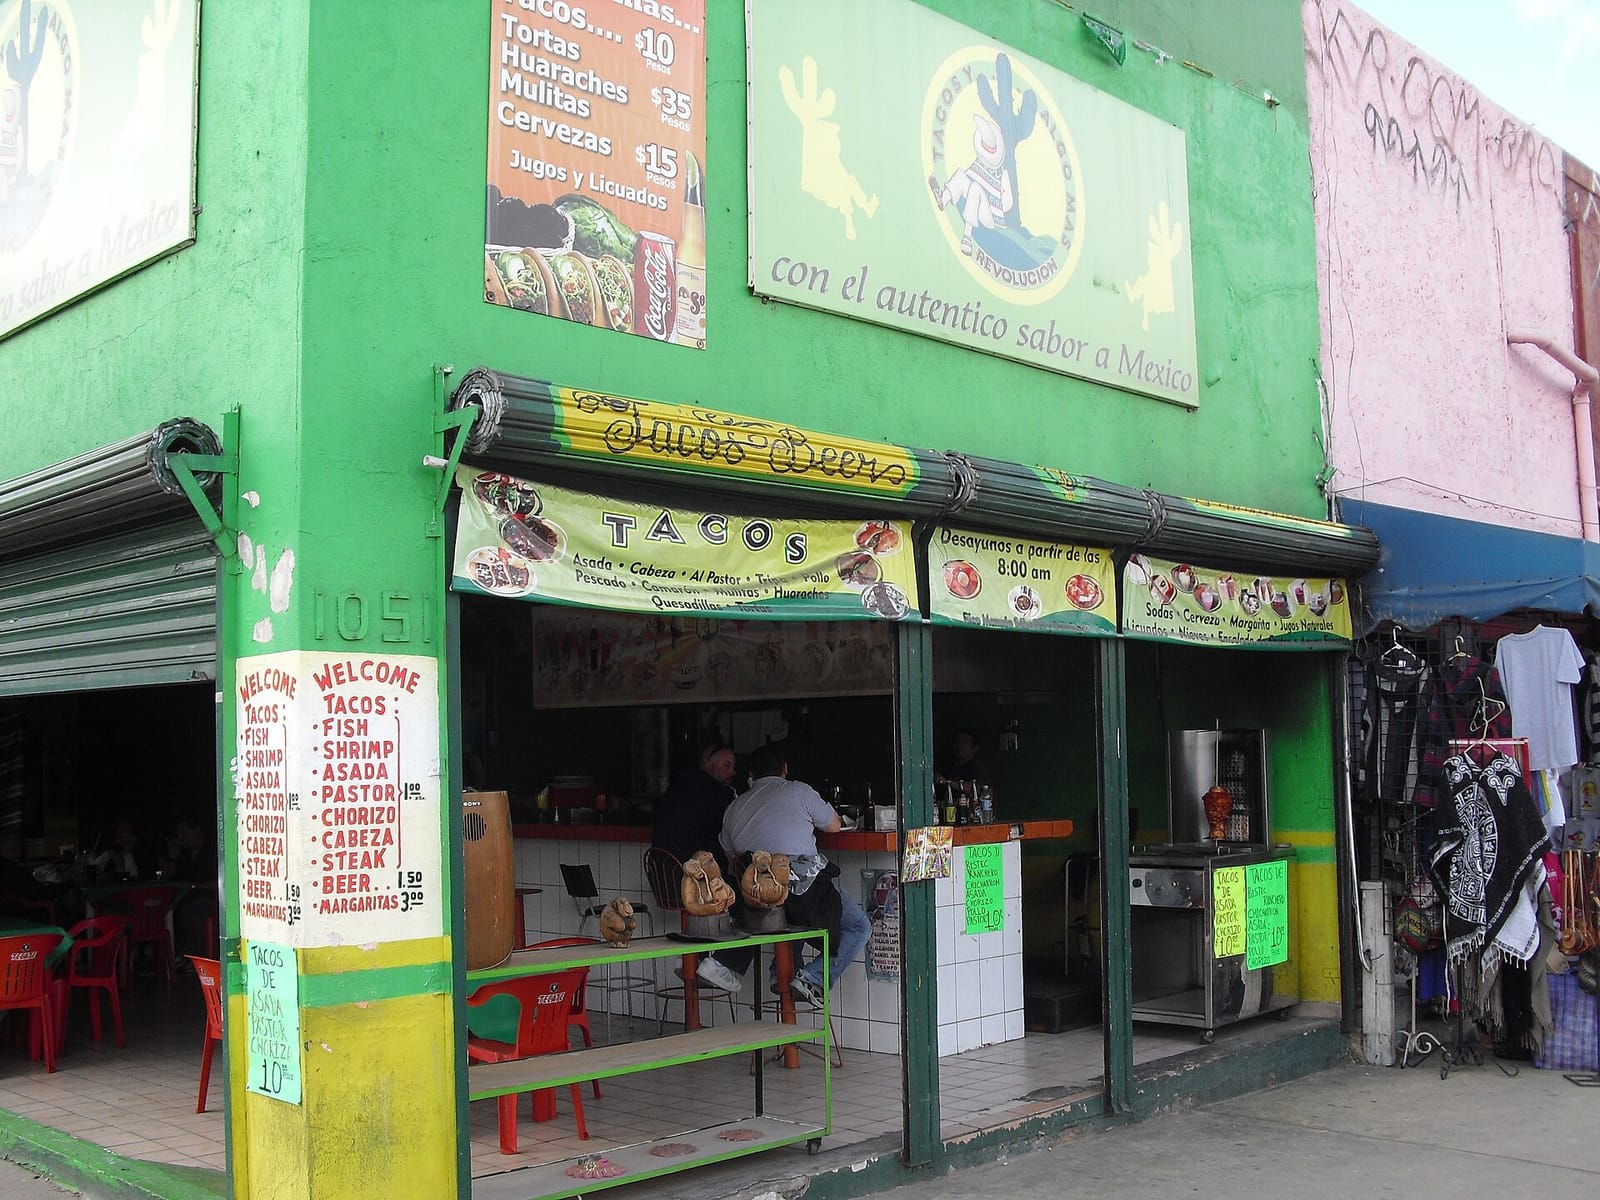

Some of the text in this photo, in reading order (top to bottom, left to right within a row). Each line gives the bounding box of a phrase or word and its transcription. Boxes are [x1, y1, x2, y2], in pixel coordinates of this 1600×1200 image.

[513, 0, 622, 43] acos....
[500, 12, 581, 61] Tortas
[634, 27, 675, 66] $10
[500, 40, 629, 104] Huaraches
[646, 59, 672, 76] Pesos
[500, 68, 592, 118] Mulitas
[650, 87, 692, 120] $35
[497, 101, 613, 157] Cervezas
[662, 114, 691, 132] Pesos
[635, 143, 678, 179] $15
[933, 75, 962, 162] TACOS
[1040, 110, 1072, 181] ALGO
[1061, 192, 1076, 250] MAS
[510, 149, 668, 211] Jugos y Licuados
[646, 172, 677, 189] Pesos
[975, 253, 1058, 288] REVOLUCION
[771, 256, 1193, 393] con el autentico sabor a Mexico
[602, 510, 808, 565] TACOS
[940, 528, 1100, 564] Desayunos a partir de las
[573, 552, 612, 571] Asada
[630, 561, 676, 579] Cabeza
[689, 569, 704, 583] Al
[706, 570, 741, 585] Pastor
[803, 571, 830, 584] Pollo
[997, 557, 1051, 580] 8:00 am
[575, 569, 626, 588] Pescado
[774, 586, 830, 600] Huaraches
[651, 595, 723, 611] Quesadillas
[1146, 603, 1334, 633] Sodas Cerveza Margarita Jugos Naturales
[240, 668, 297, 704] WELCOME
[313, 660, 421, 694] WELCOME
[245, 727, 269, 746] FISH
[322, 718, 368, 738] FISH
[245, 749, 283, 768] SHRIMP
[323, 740, 394, 759] SHRIMP
[246, 771, 280, 790] ASADA
[322, 762, 389, 782] ASADA
[246, 792, 285, 811] PASTOR
[322, 784, 395, 803] PASTOR
[246, 815, 285, 834] CHORIZO
[321, 806, 396, 827] CHORIZO
[246, 836, 284, 856] CABEZA
[322, 828, 394, 849] CABEZA
[322, 848, 387, 871] STEAK
[966, 846, 992, 858] TACOS
[247, 857, 280, 878] STEAK
[1249, 867, 1273, 884] TACOS
[1216, 872, 1239, 885] TACOS
[966, 889, 987, 898] ASADA
[1221, 886, 1231, 898] DE
[246, 902, 286, 922] MARGARITAS
[319, 895, 399, 915] MARGARITAS
[1216, 899, 1236, 911] ASADA
[1216, 911, 1239, 924] PASTOR
[251, 945, 284, 968] TACOS
[262, 968, 276, 989] DE
[252, 990, 284, 1018] ASADA
[251, 1011, 288, 1042] PASTOR
[251, 1036, 292, 1062] CHORIZO
